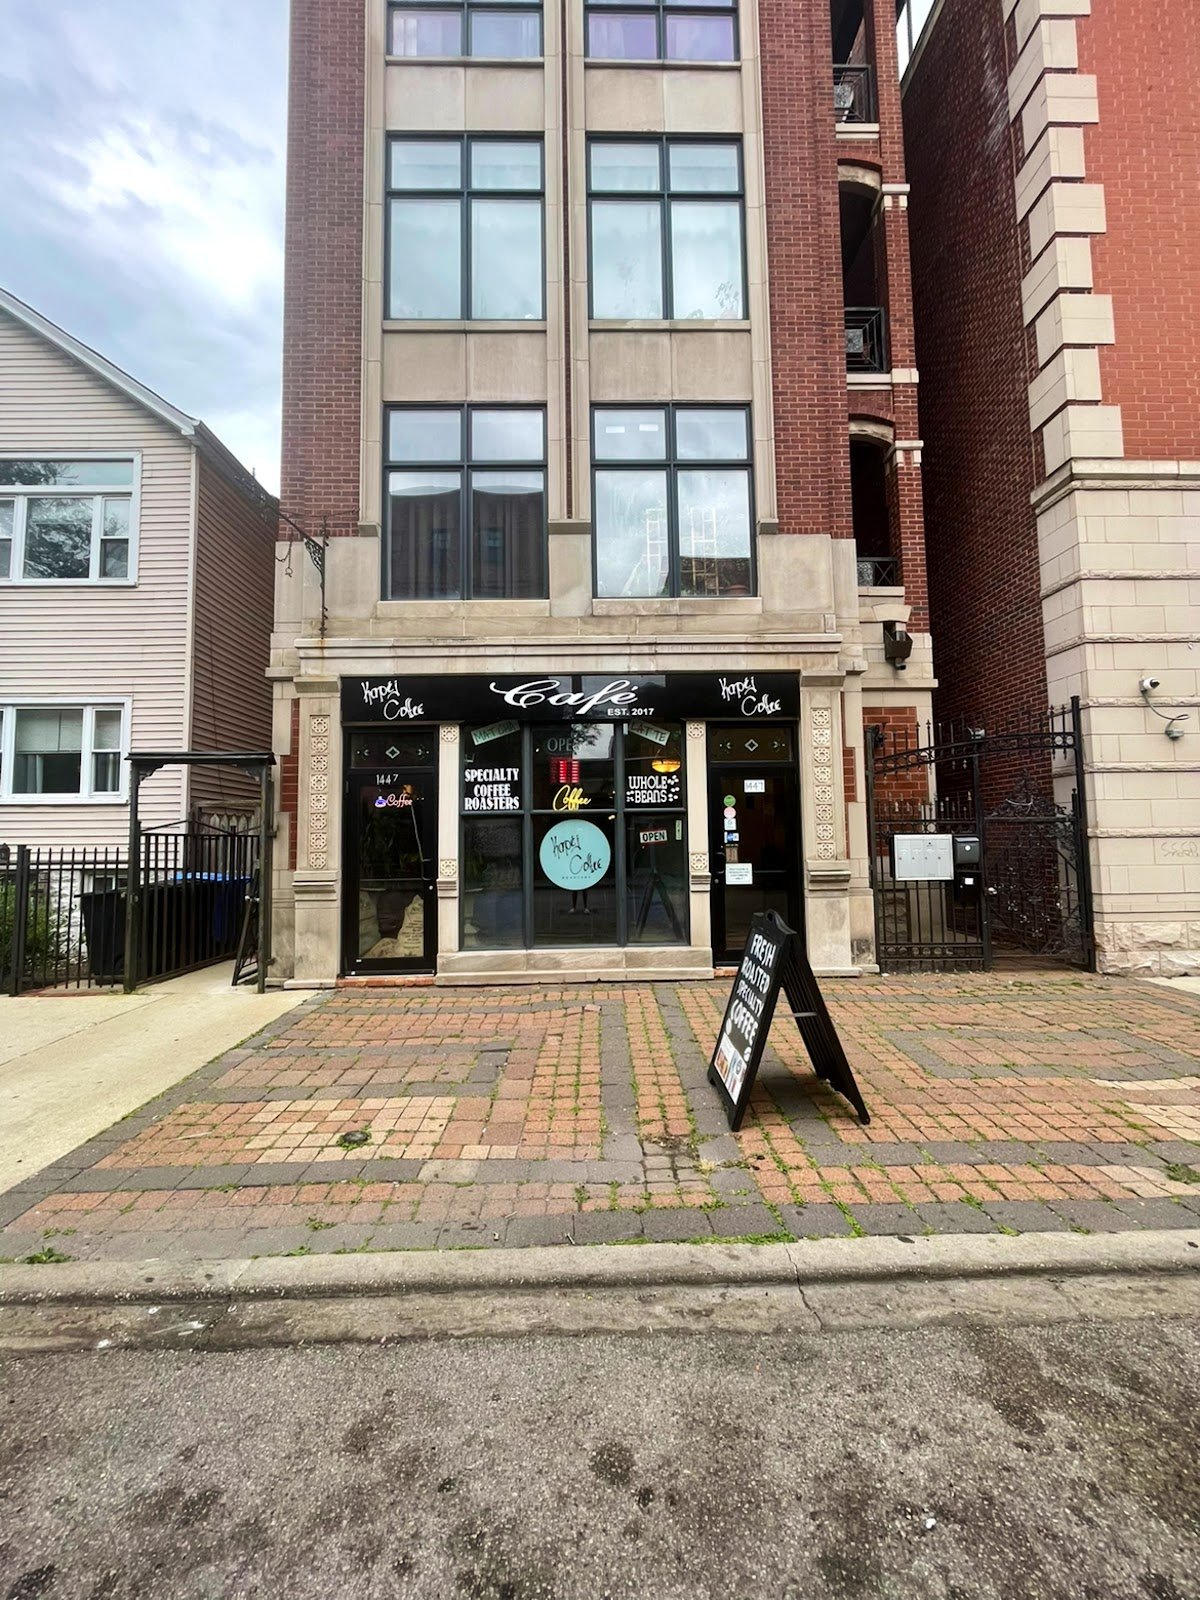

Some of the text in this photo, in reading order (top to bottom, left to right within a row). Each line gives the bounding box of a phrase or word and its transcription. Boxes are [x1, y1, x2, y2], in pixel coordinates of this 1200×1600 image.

[489, 679, 639, 715] Café
[741, 693, 782, 716] Coffee
[383, 697, 425, 720] Coffee
[607, 707, 655, 716] EST. 2017
[376, 773, 399, 785] 1447
[464, 768, 520, 782] SPECIALTY
[628, 775, 668, 789] WHOLE
[473, 783, 511, 797] COFFEE
[552, 784, 592, 811] Coffee
[634, 789, 668, 804] BEANS
[385, 793, 413, 808] Coffee
[464, 796, 520, 811] ROASTERS
[642, 831, 666, 842] OPEN
[569, 852, 602, 875] Coffee
[750, 933, 777, 968] FRESH
[740, 956, 771, 994] ROASTED
[736, 980, 765, 1018] SPECIALTY
[730, 999, 759, 1047] COFFEE
